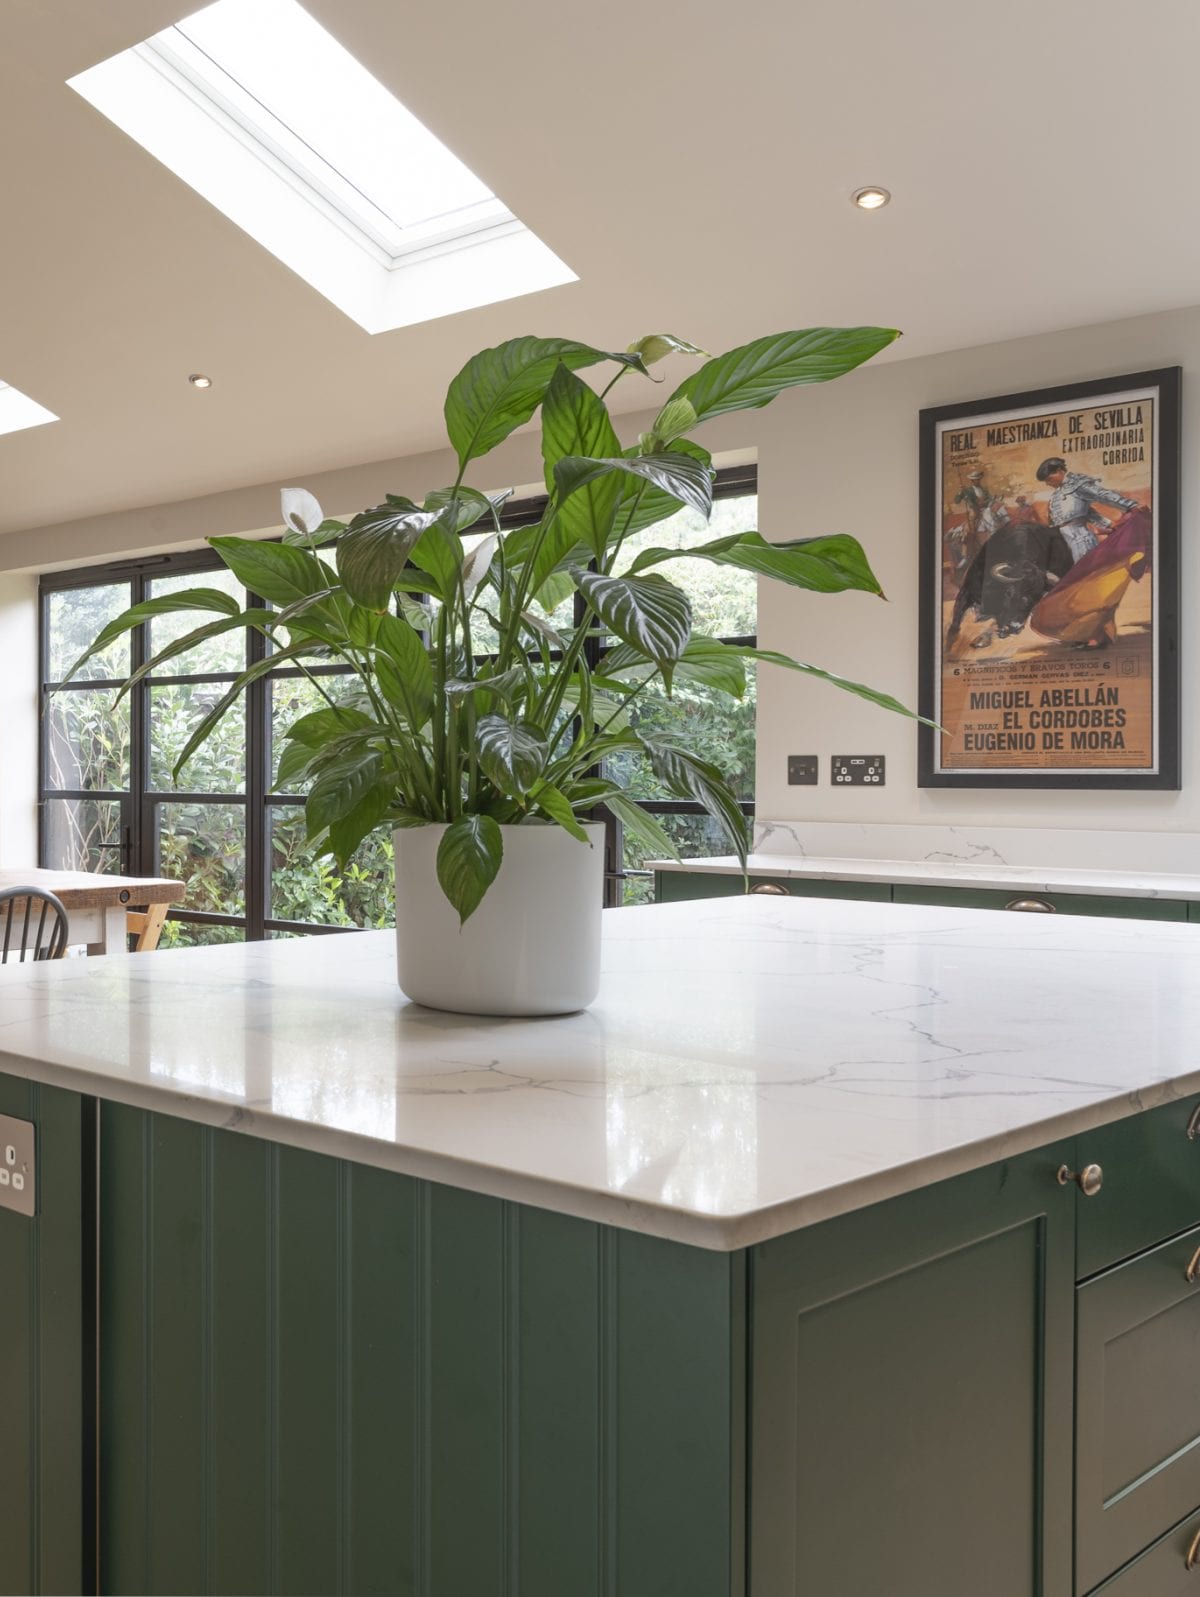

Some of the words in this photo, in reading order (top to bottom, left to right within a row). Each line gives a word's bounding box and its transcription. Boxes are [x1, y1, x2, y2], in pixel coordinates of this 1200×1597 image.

[950, 432, 977, 452] REAL
[986, 418, 1058, 447] MAESTRANZA
[1069, 415, 1084, 435] DE
[1094, 406, 1143, 431] SEVILLA
[1062, 428, 1145, 454] EXTRAORDINARIA
[1103, 446, 1145, 466] CORRIDA
[953, 668, 960, 676] 6
[1069, 661, 1099, 670] TOROS
[1102, 661, 1111, 670] 6
[970, 690, 1034, 710] MIGUEL
[1039, 682, 1119, 708] ABELLÁN
[1003, 711, 1023, 730] EL
[1029, 708, 1127, 730] CORDOBES
[964, 732, 1036, 751] EUGENIO
[1042, 731, 1064, 750] DE
[1071, 731, 1125, 749] MORA
